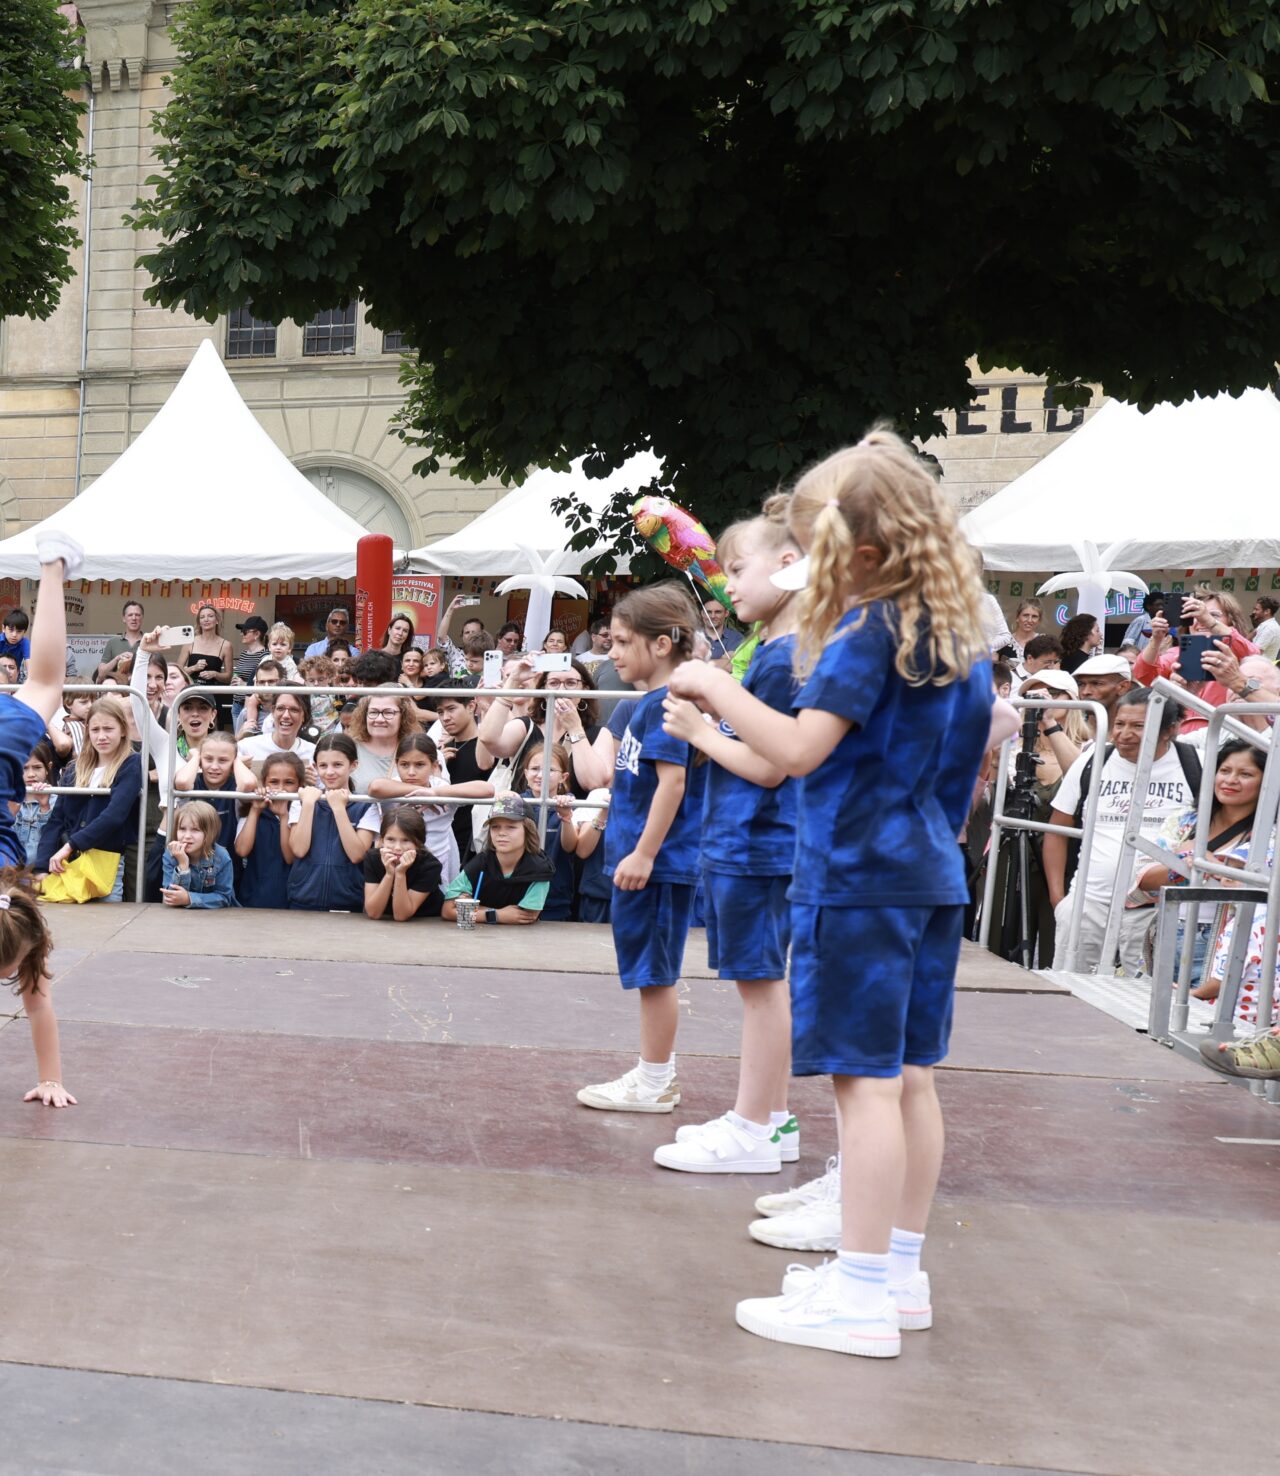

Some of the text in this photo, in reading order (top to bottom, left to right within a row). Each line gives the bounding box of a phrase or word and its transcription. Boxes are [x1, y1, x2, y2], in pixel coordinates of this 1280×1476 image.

[955, 385, 1085, 435] ELD
[408, 580, 434, 589] FESTIVAL
[392, 586, 437, 607] IENTE!
[1148, 782, 1184, 804] ONES
